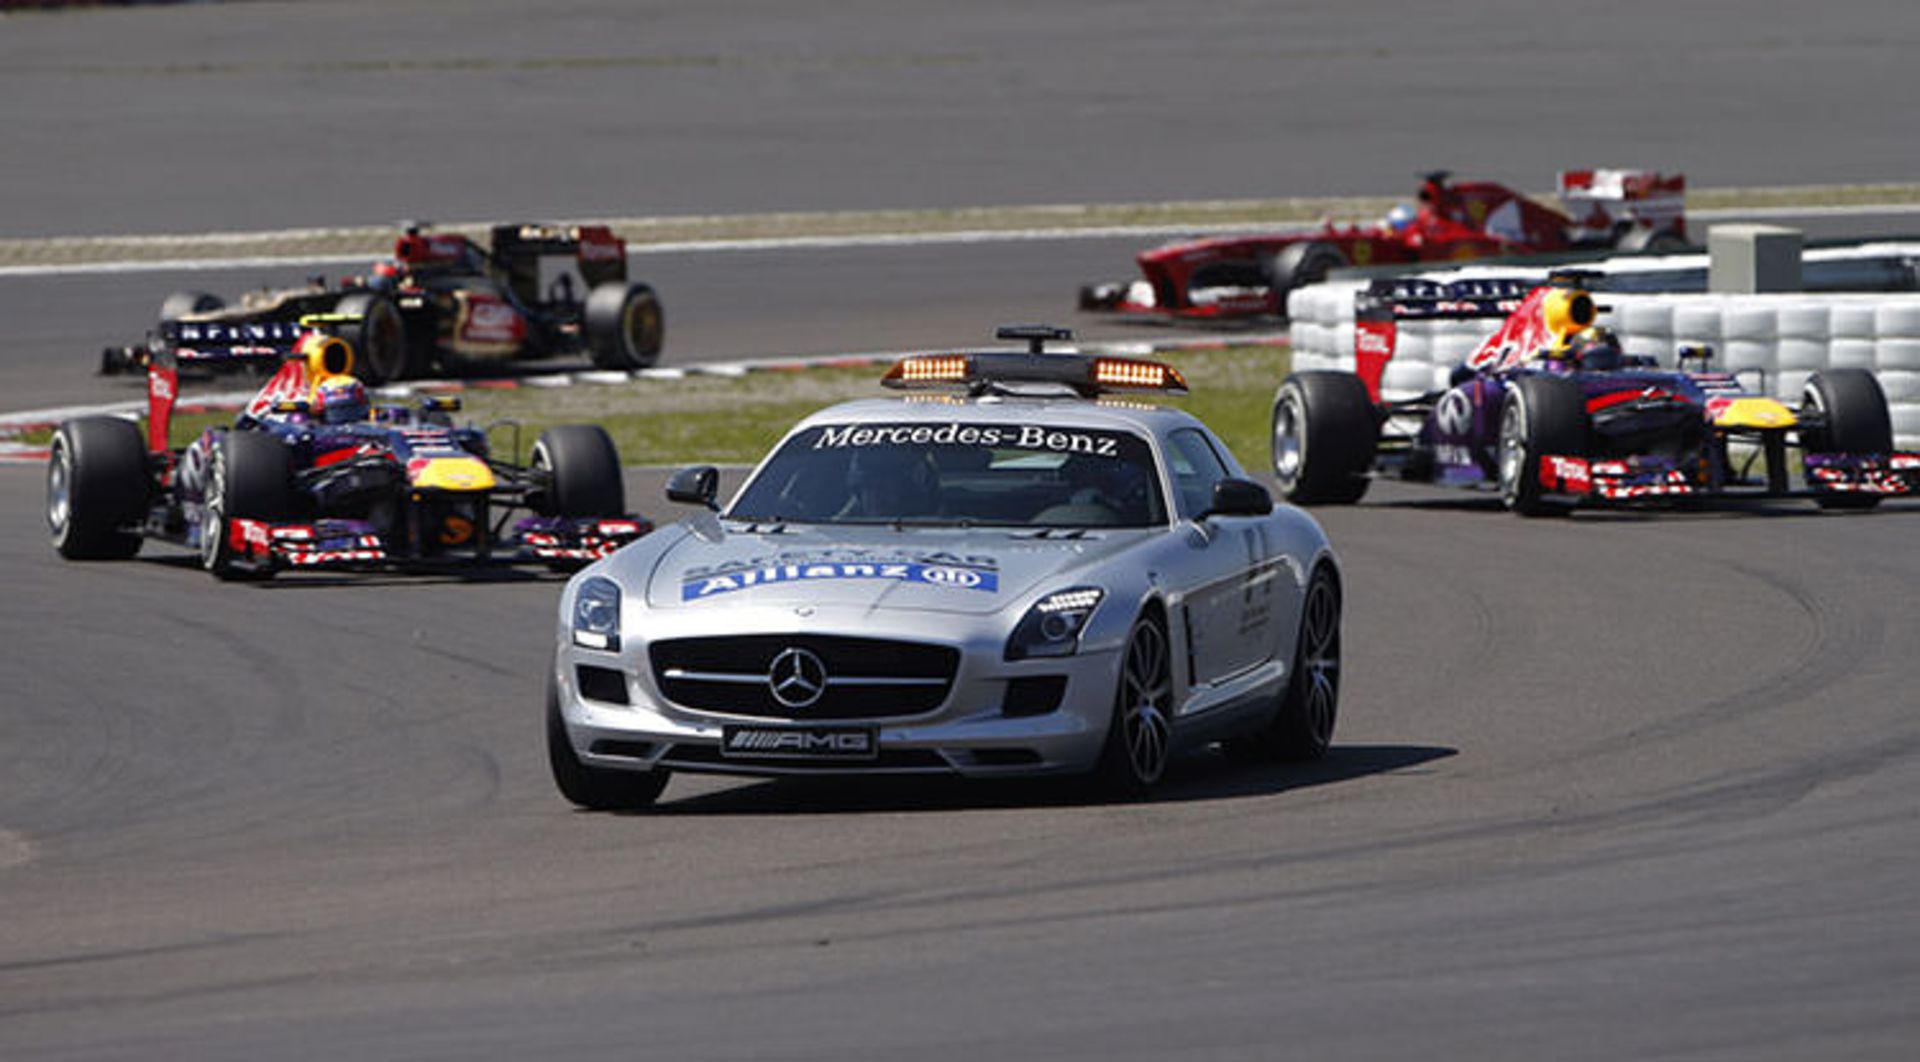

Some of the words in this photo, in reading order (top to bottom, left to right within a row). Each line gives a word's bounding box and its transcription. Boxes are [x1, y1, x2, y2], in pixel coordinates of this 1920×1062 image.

[814, 422, 1118, 456] Mercedes-Benz
[700, 563, 909, 595] Allianz
[773, 732, 868, 749] AMG
